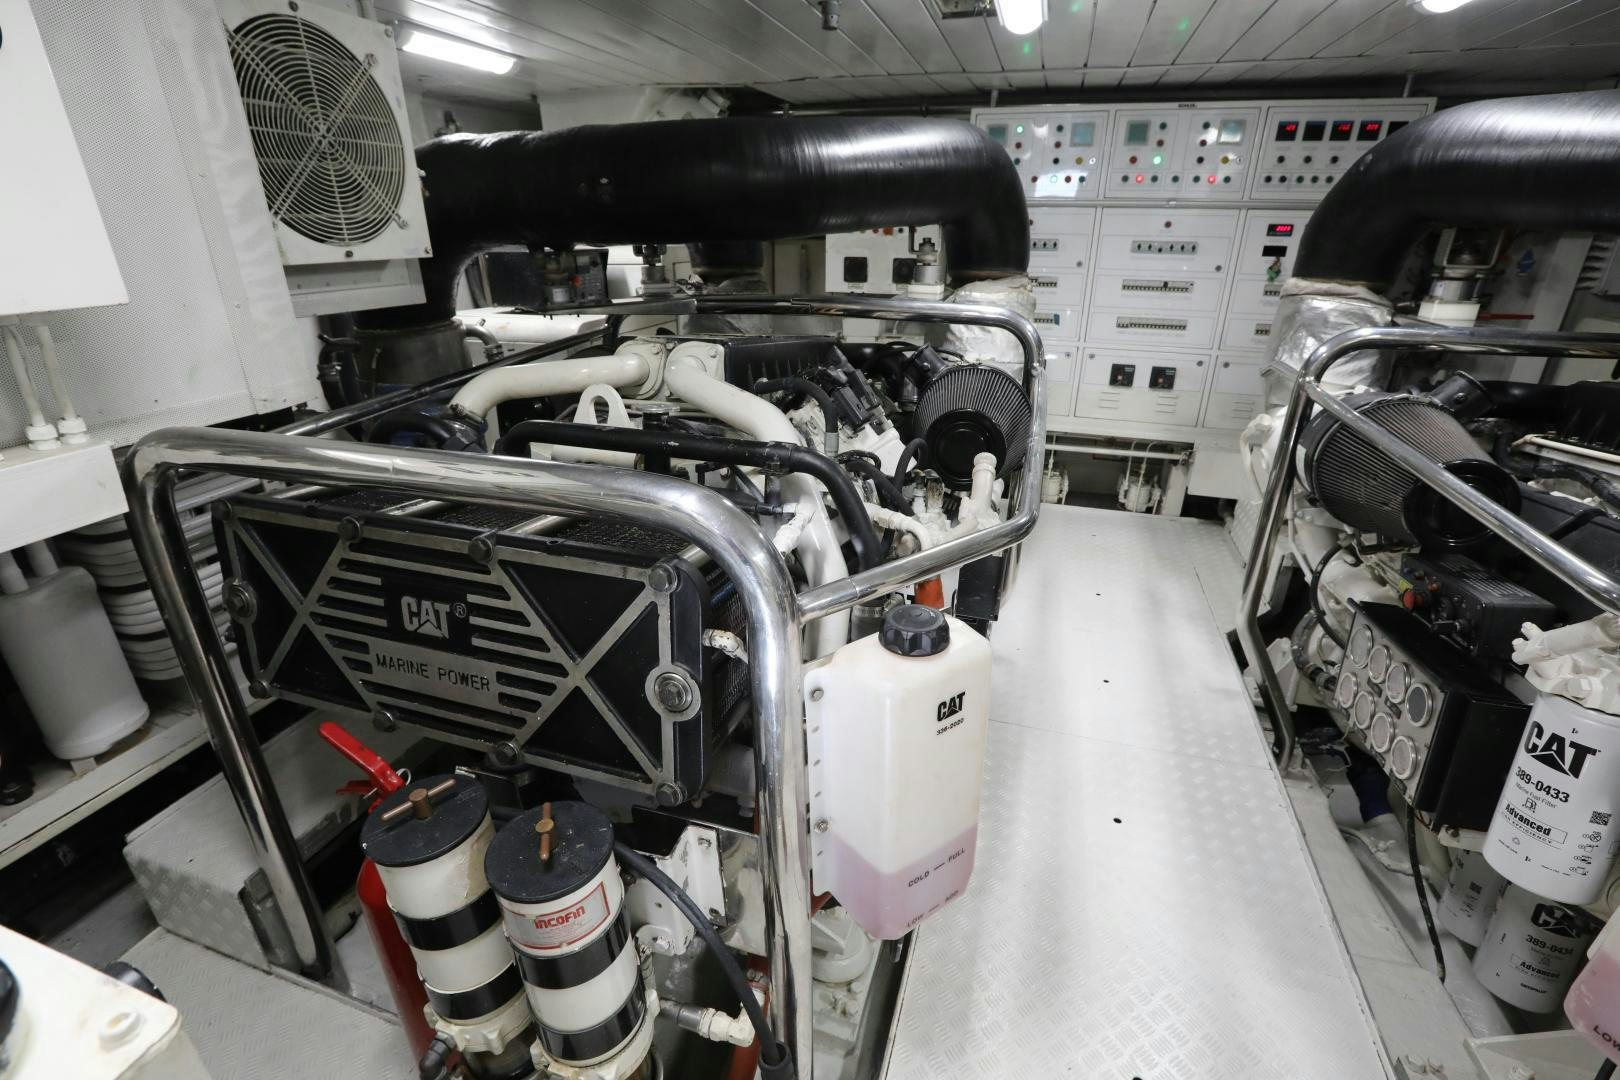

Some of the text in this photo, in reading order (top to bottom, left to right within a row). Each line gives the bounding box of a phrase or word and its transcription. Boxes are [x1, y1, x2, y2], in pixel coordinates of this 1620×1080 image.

[375, 652, 490, 692] MARINE POWER
[937, 691, 966, 722] CAT
[1524, 720, 1598, 780] CAT
[1515, 766, 1570, 803] 389-0433
[1505, 803, 1552, 837] Advanced
[908, 870, 930, 888] COLD
